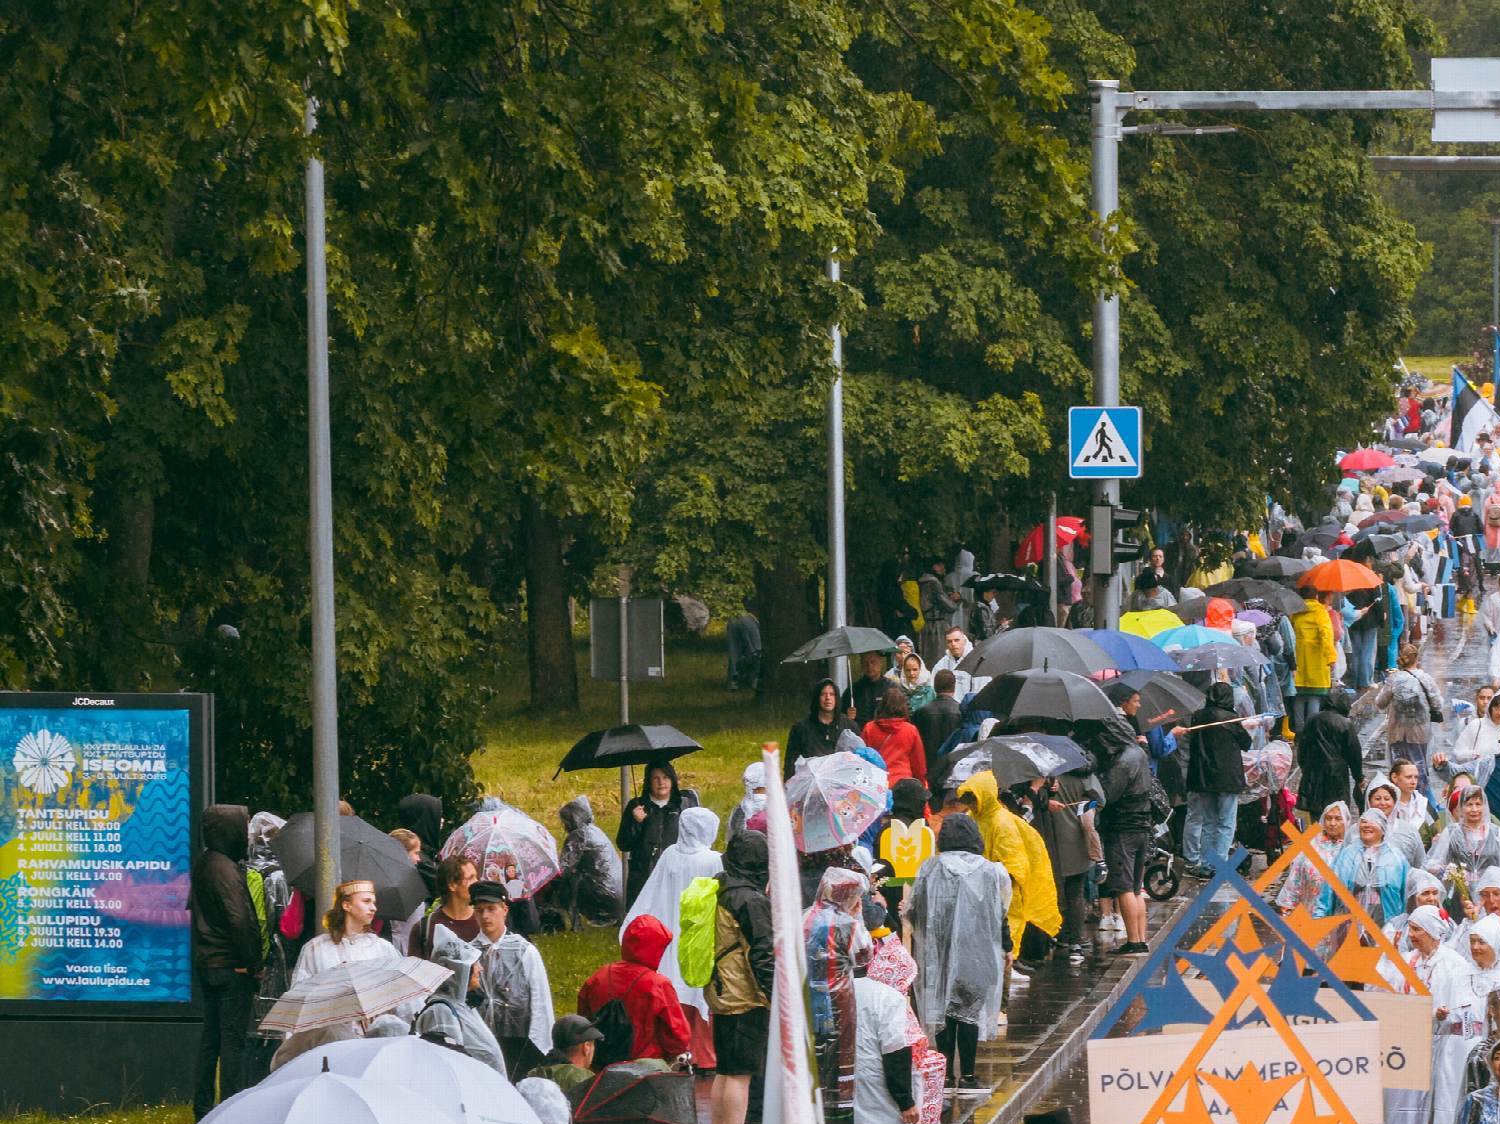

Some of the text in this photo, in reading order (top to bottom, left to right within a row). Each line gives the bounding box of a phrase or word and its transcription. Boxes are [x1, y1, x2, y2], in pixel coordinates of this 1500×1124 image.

[72, 697, 115, 706] JCDecaux
[82, 759, 168, 772] ISEOMA
[17, 809, 109, 820] TANTSUPIDU
[30, 821, 63, 831] JUULI
[65, 821, 91, 831] KELL
[30, 832, 63, 842] JUULI
[66, 832, 91, 842] KELL
[30, 843, 63, 853] JUULI
[66, 843, 91, 853] KELL
[17, 859, 171, 871] RAHVAMUUSIKAPIDU
[31, 872, 63, 881] JUULI
[66, 872, 91, 881] KELL
[17, 885, 97, 898] RONGKÄIK
[31, 900, 64, 909] JUULI
[66, 900, 92, 910] KELL
[17, 915, 101, 926] LAULUPIDU
[31, 928, 64, 937] JUULI
[66, 928, 92, 937] KELL
[31, 939, 64, 948] JUULI
[66, 939, 92, 949] KELL
[42, 975, 151, 988] www.laulupidu.ee
